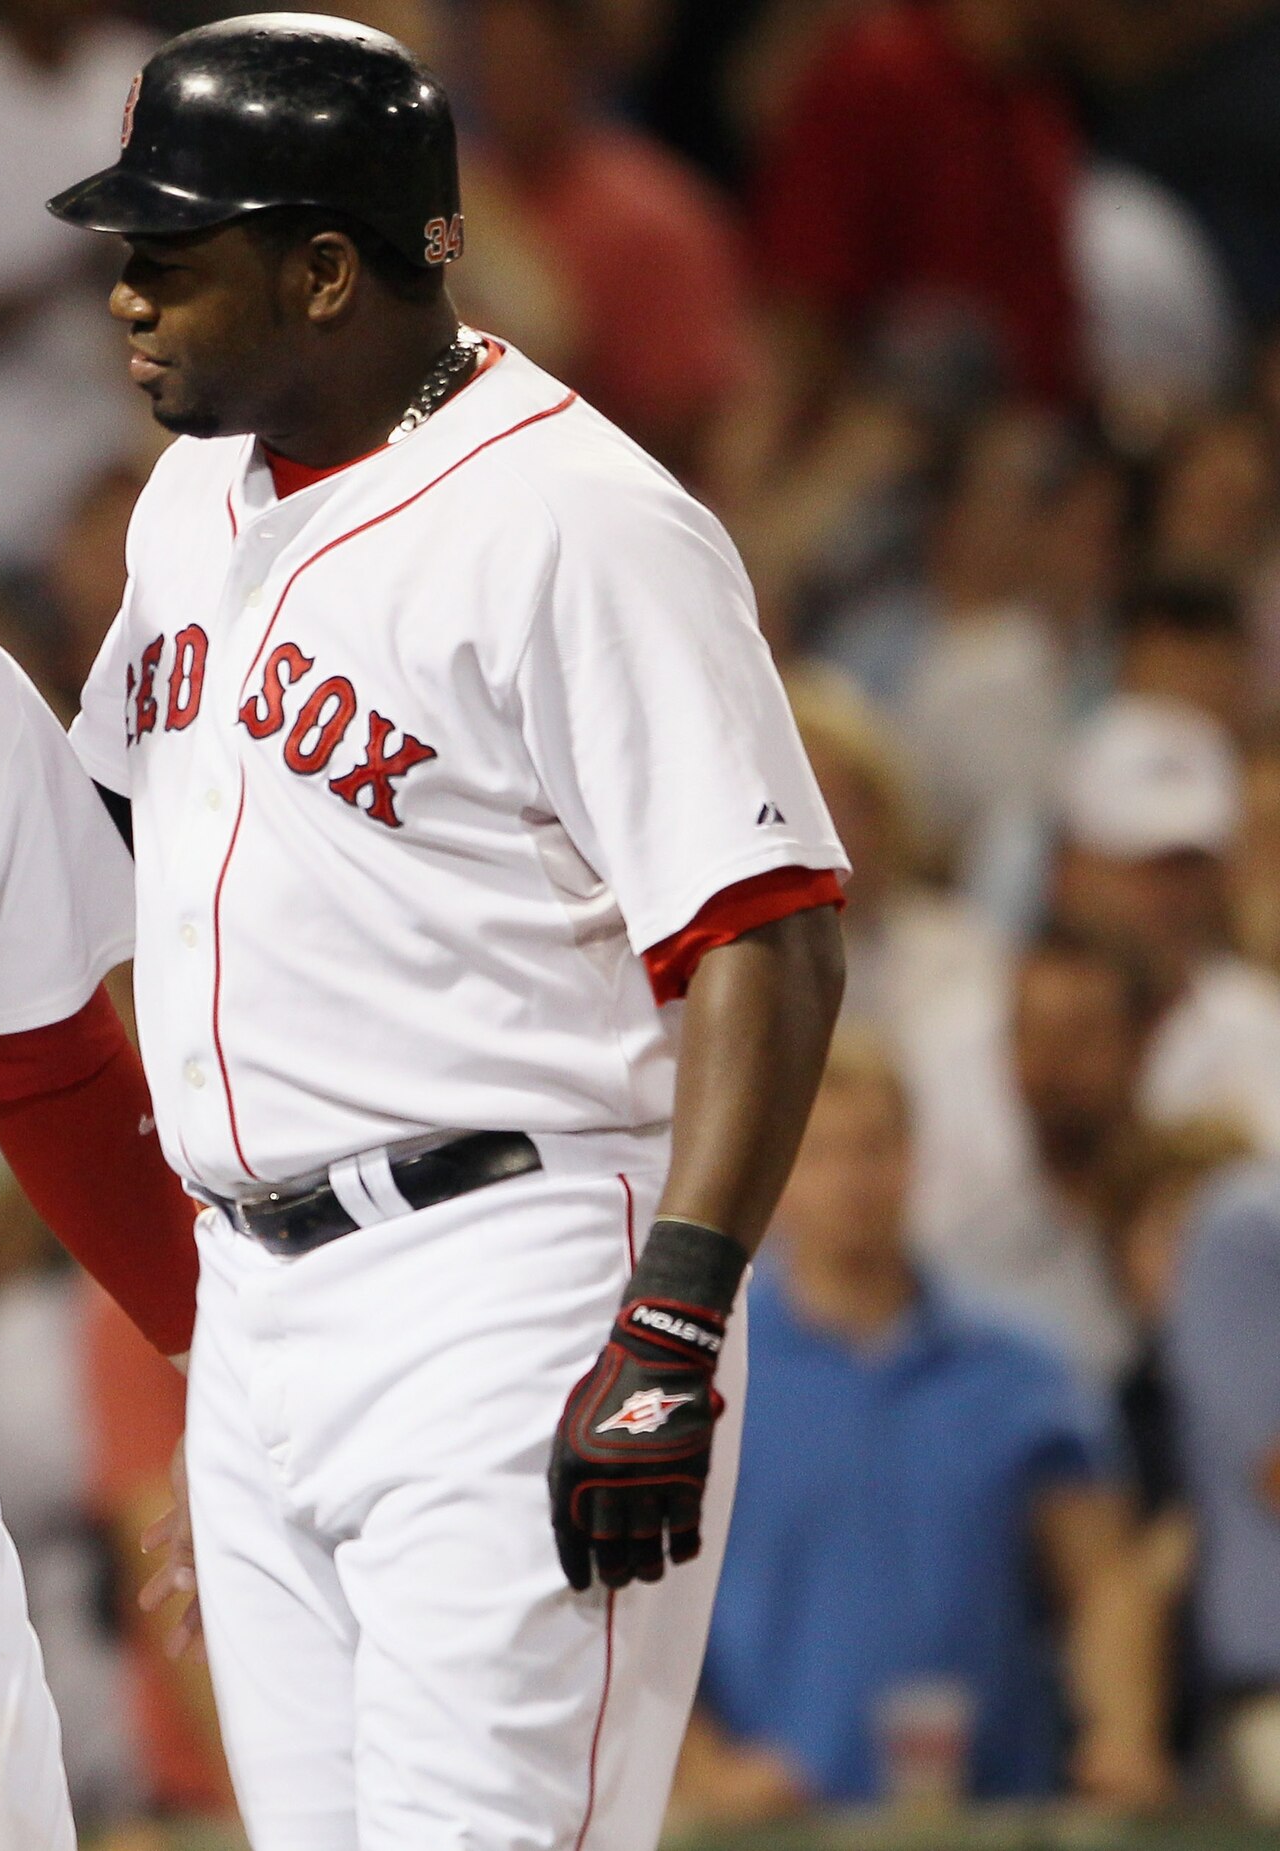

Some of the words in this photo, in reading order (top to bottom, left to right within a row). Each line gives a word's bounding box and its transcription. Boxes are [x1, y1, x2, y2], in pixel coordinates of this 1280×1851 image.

[424, 214, 463, 264] 34
[126, 623, 209, 748] ED
[238, 641, 437, 828] SOX
